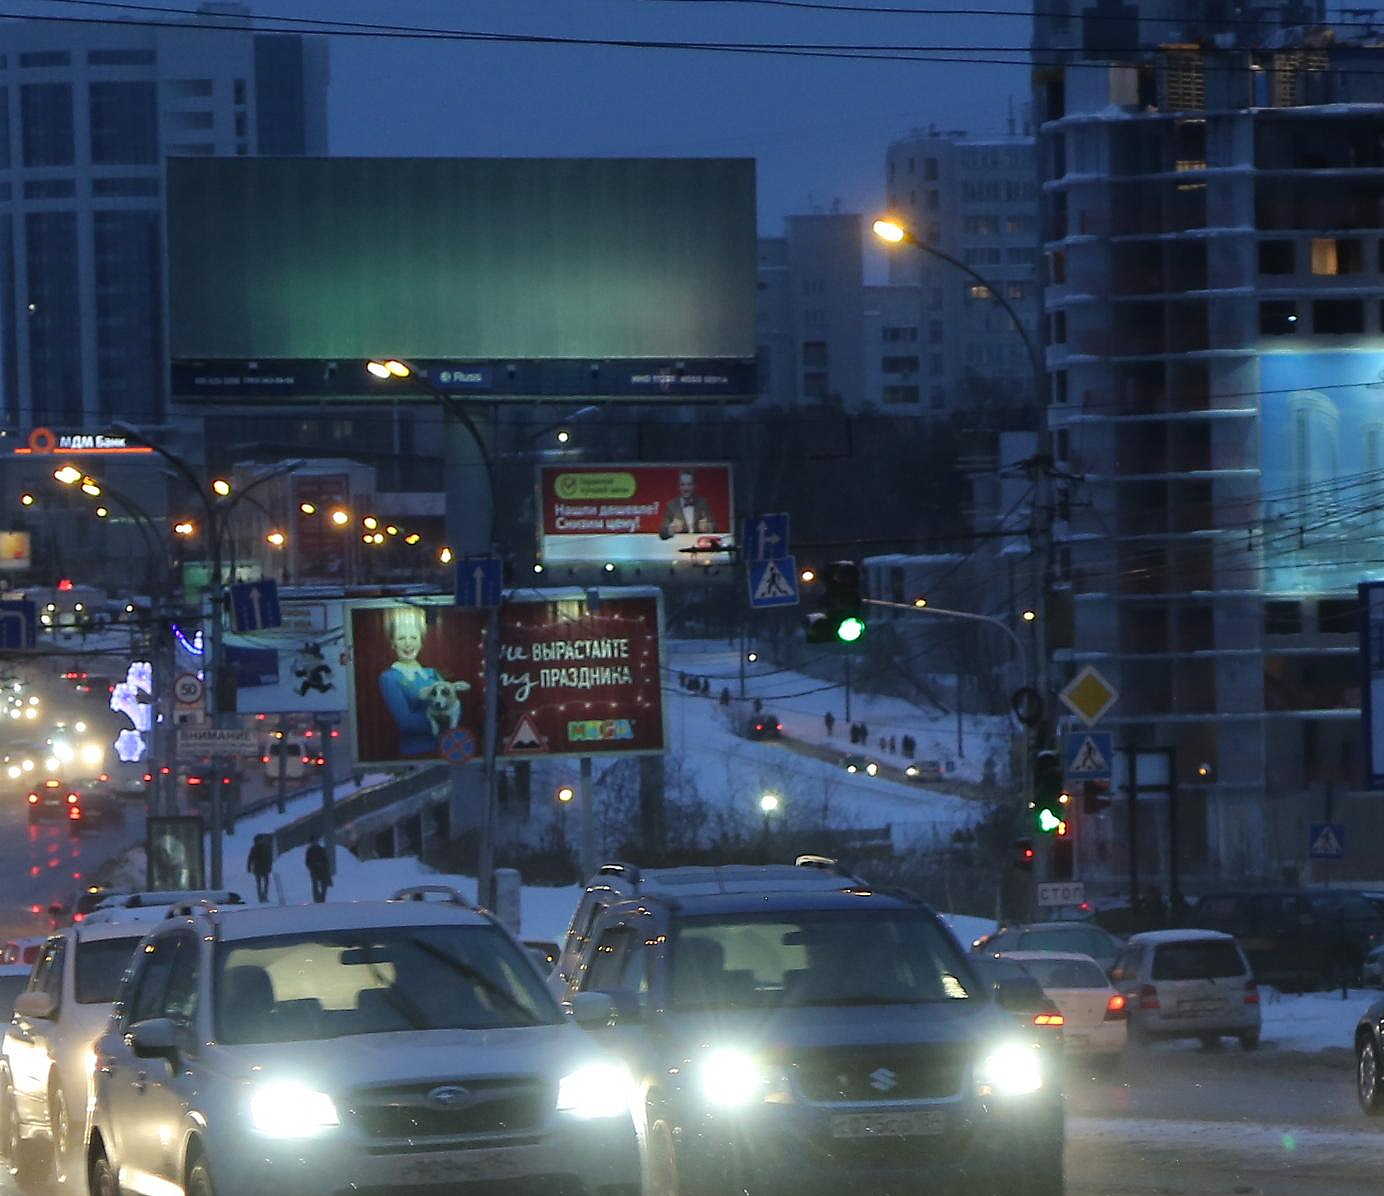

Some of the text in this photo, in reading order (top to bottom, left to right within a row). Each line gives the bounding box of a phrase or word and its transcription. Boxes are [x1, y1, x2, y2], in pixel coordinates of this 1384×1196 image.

[59, 435, 127, 449] МДМ Банк
[531, 637, 630, 662] ВЫРАСТАЙТЕ
[540, 666, 632, 689] ПРАЗДНИКА
[181, 683, 198, 695] 50
[1039, 887, 1083, 900] СТОП
